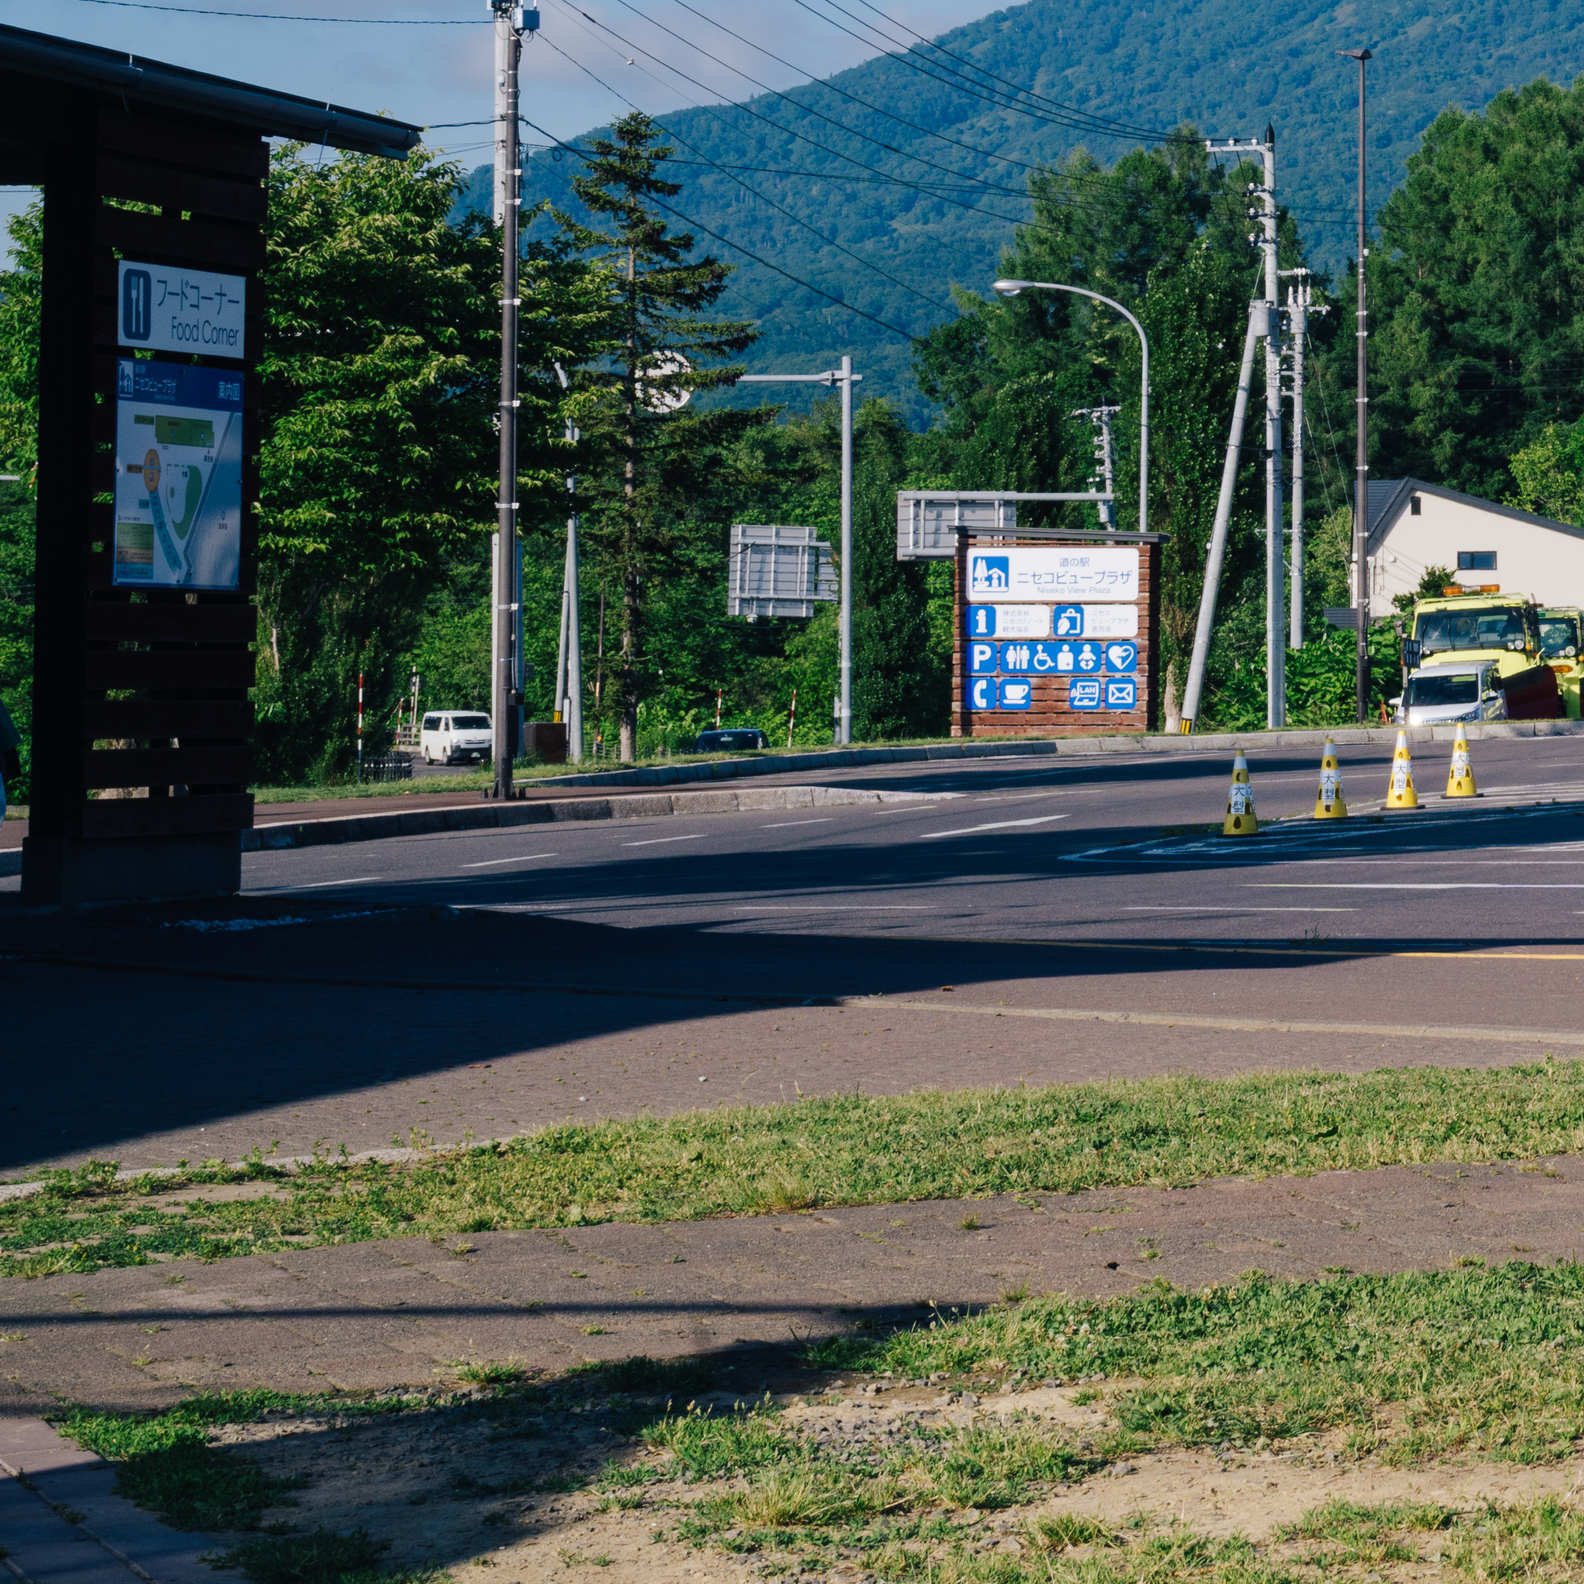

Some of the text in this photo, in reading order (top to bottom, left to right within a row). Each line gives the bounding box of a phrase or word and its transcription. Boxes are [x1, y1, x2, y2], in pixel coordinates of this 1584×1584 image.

[157, 278, 240, 316] フードコーナー
[172, 316, 239, 347] Food Corner
[218, 380, 240, 401] 案内図
[1059, 557, 1090, 567] 道の駅
[1017, 570, 1133, 585] ニセコビュープラザ
[973, 645, 992, 670] P
[1323, 773, 1335, 800] 大型
[1395, 763, 1406, 789] 大型
[1232, 784, 1245, 813] 大型
